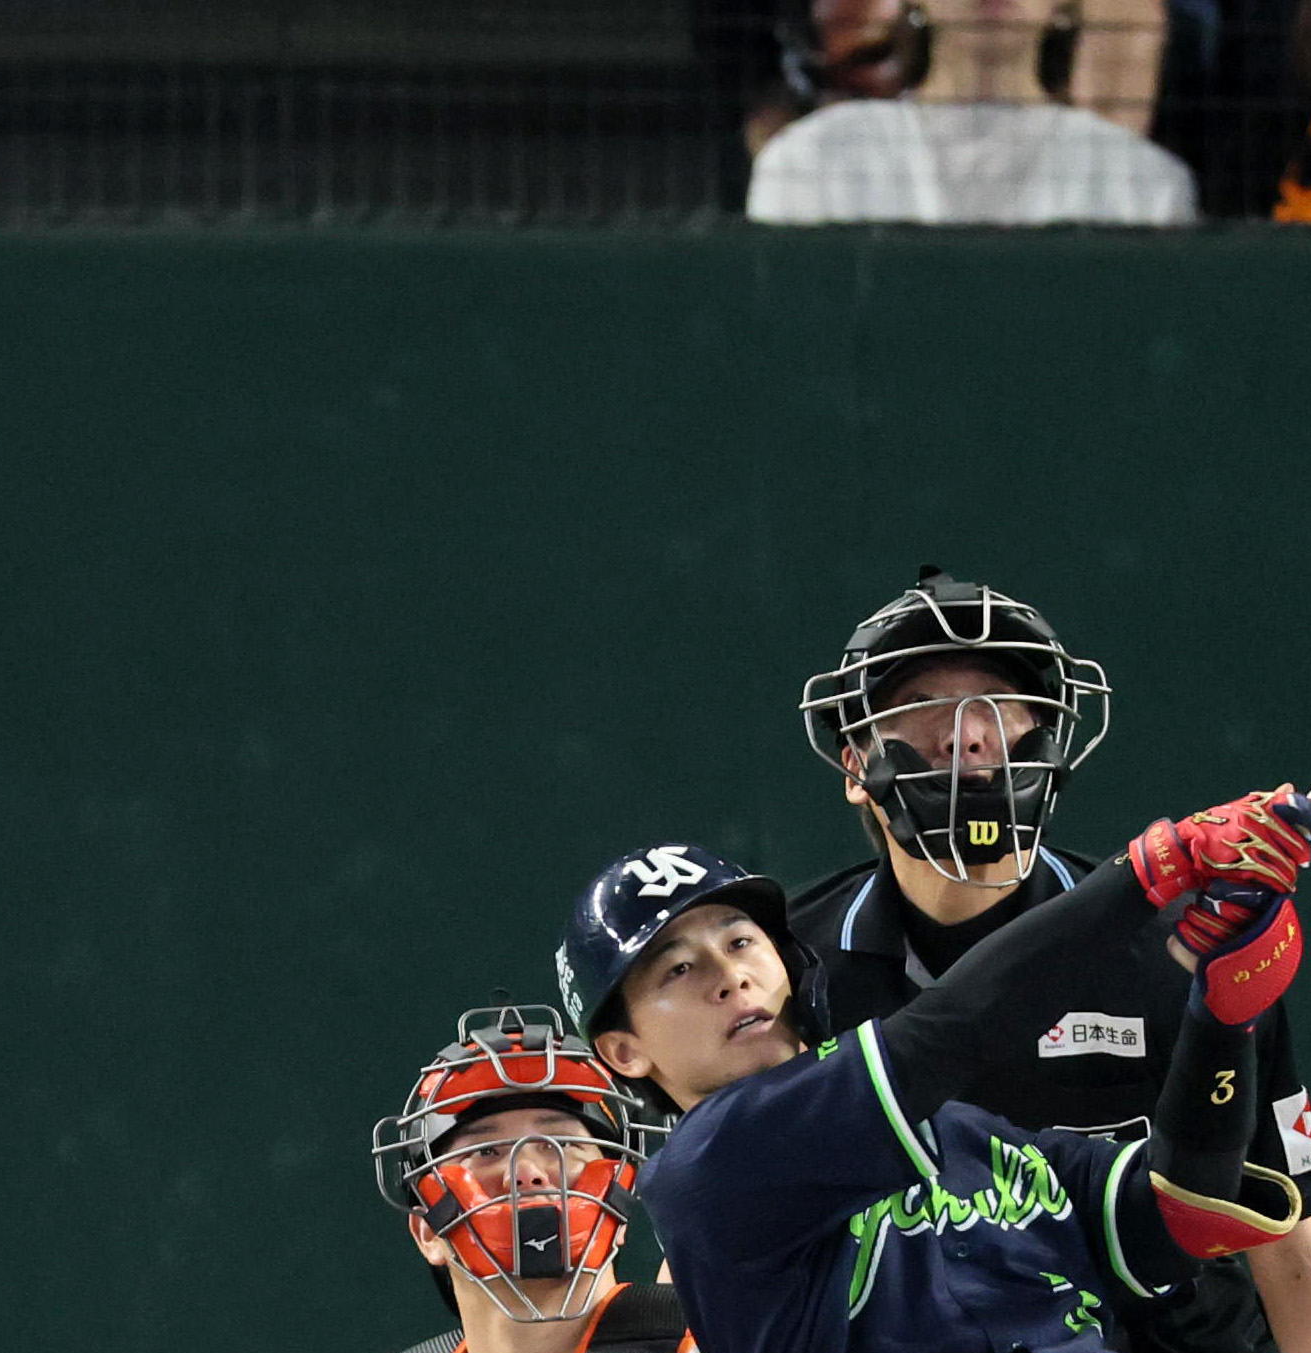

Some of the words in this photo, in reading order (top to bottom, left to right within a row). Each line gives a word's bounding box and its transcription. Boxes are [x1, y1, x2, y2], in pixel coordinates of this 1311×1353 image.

[1072, 1024, 1138, 1046] 日本生命
[1209, 1069, 1237, 1106] 3
